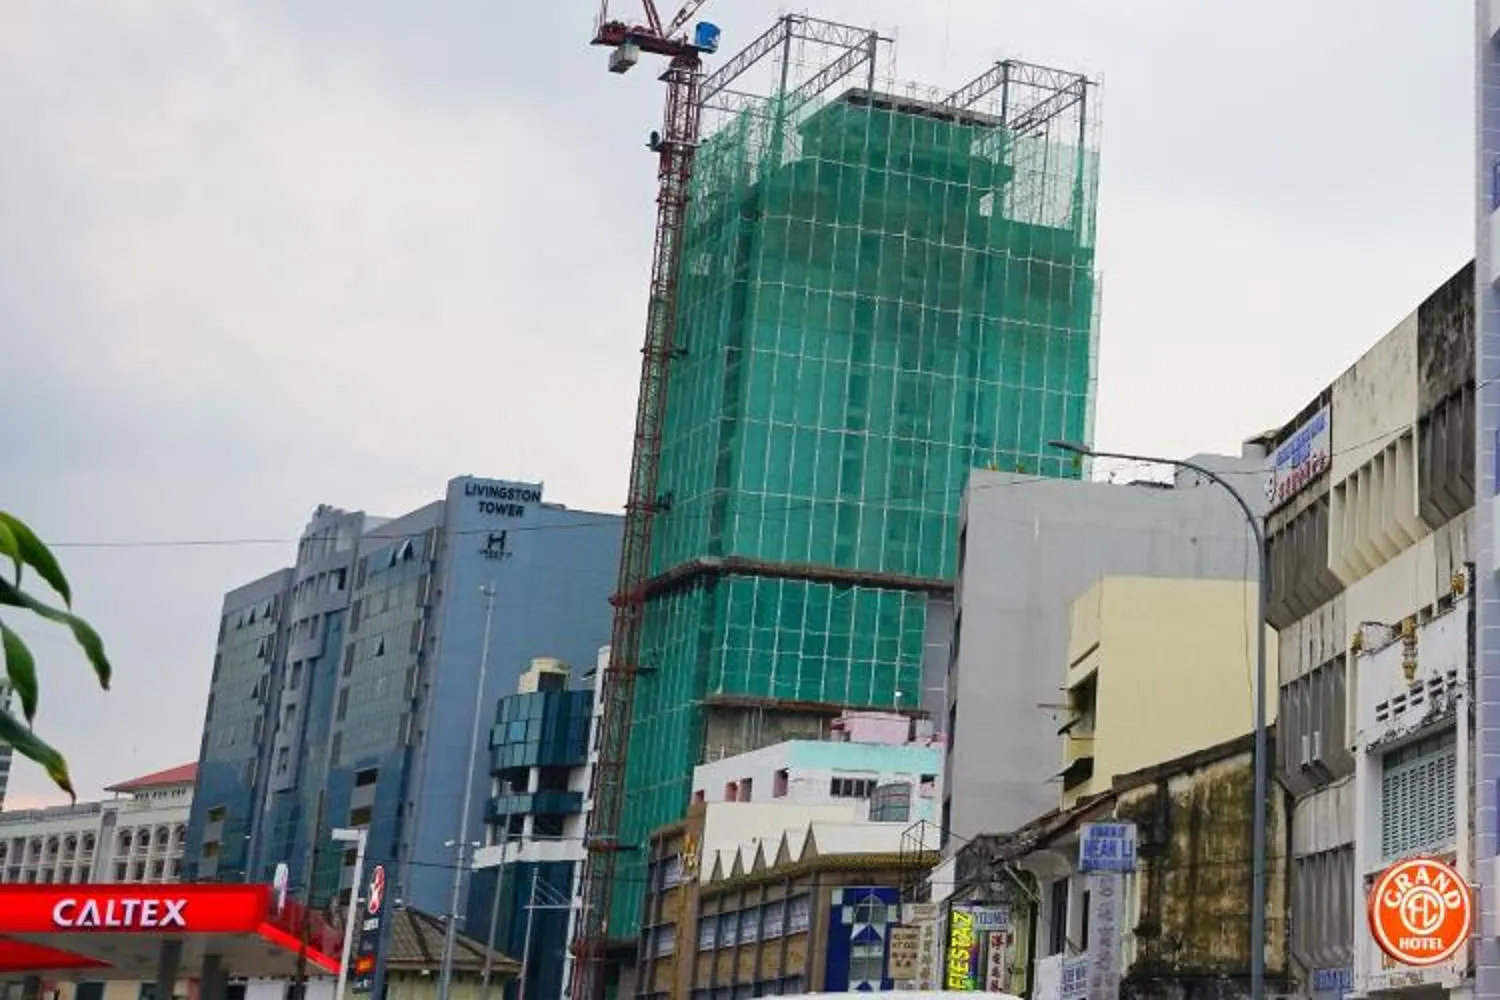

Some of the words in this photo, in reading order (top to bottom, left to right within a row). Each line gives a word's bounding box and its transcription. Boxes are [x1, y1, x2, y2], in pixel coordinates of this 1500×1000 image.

[464, 483, 541, 503] LIVINGSTON
[479, 501, 525, 518] TOWER
[1384, 867, 1461, 909] GRAND
[52, 898, 188, 927] CALTEX
[1399, 937, 1443, 950] HOTEL
